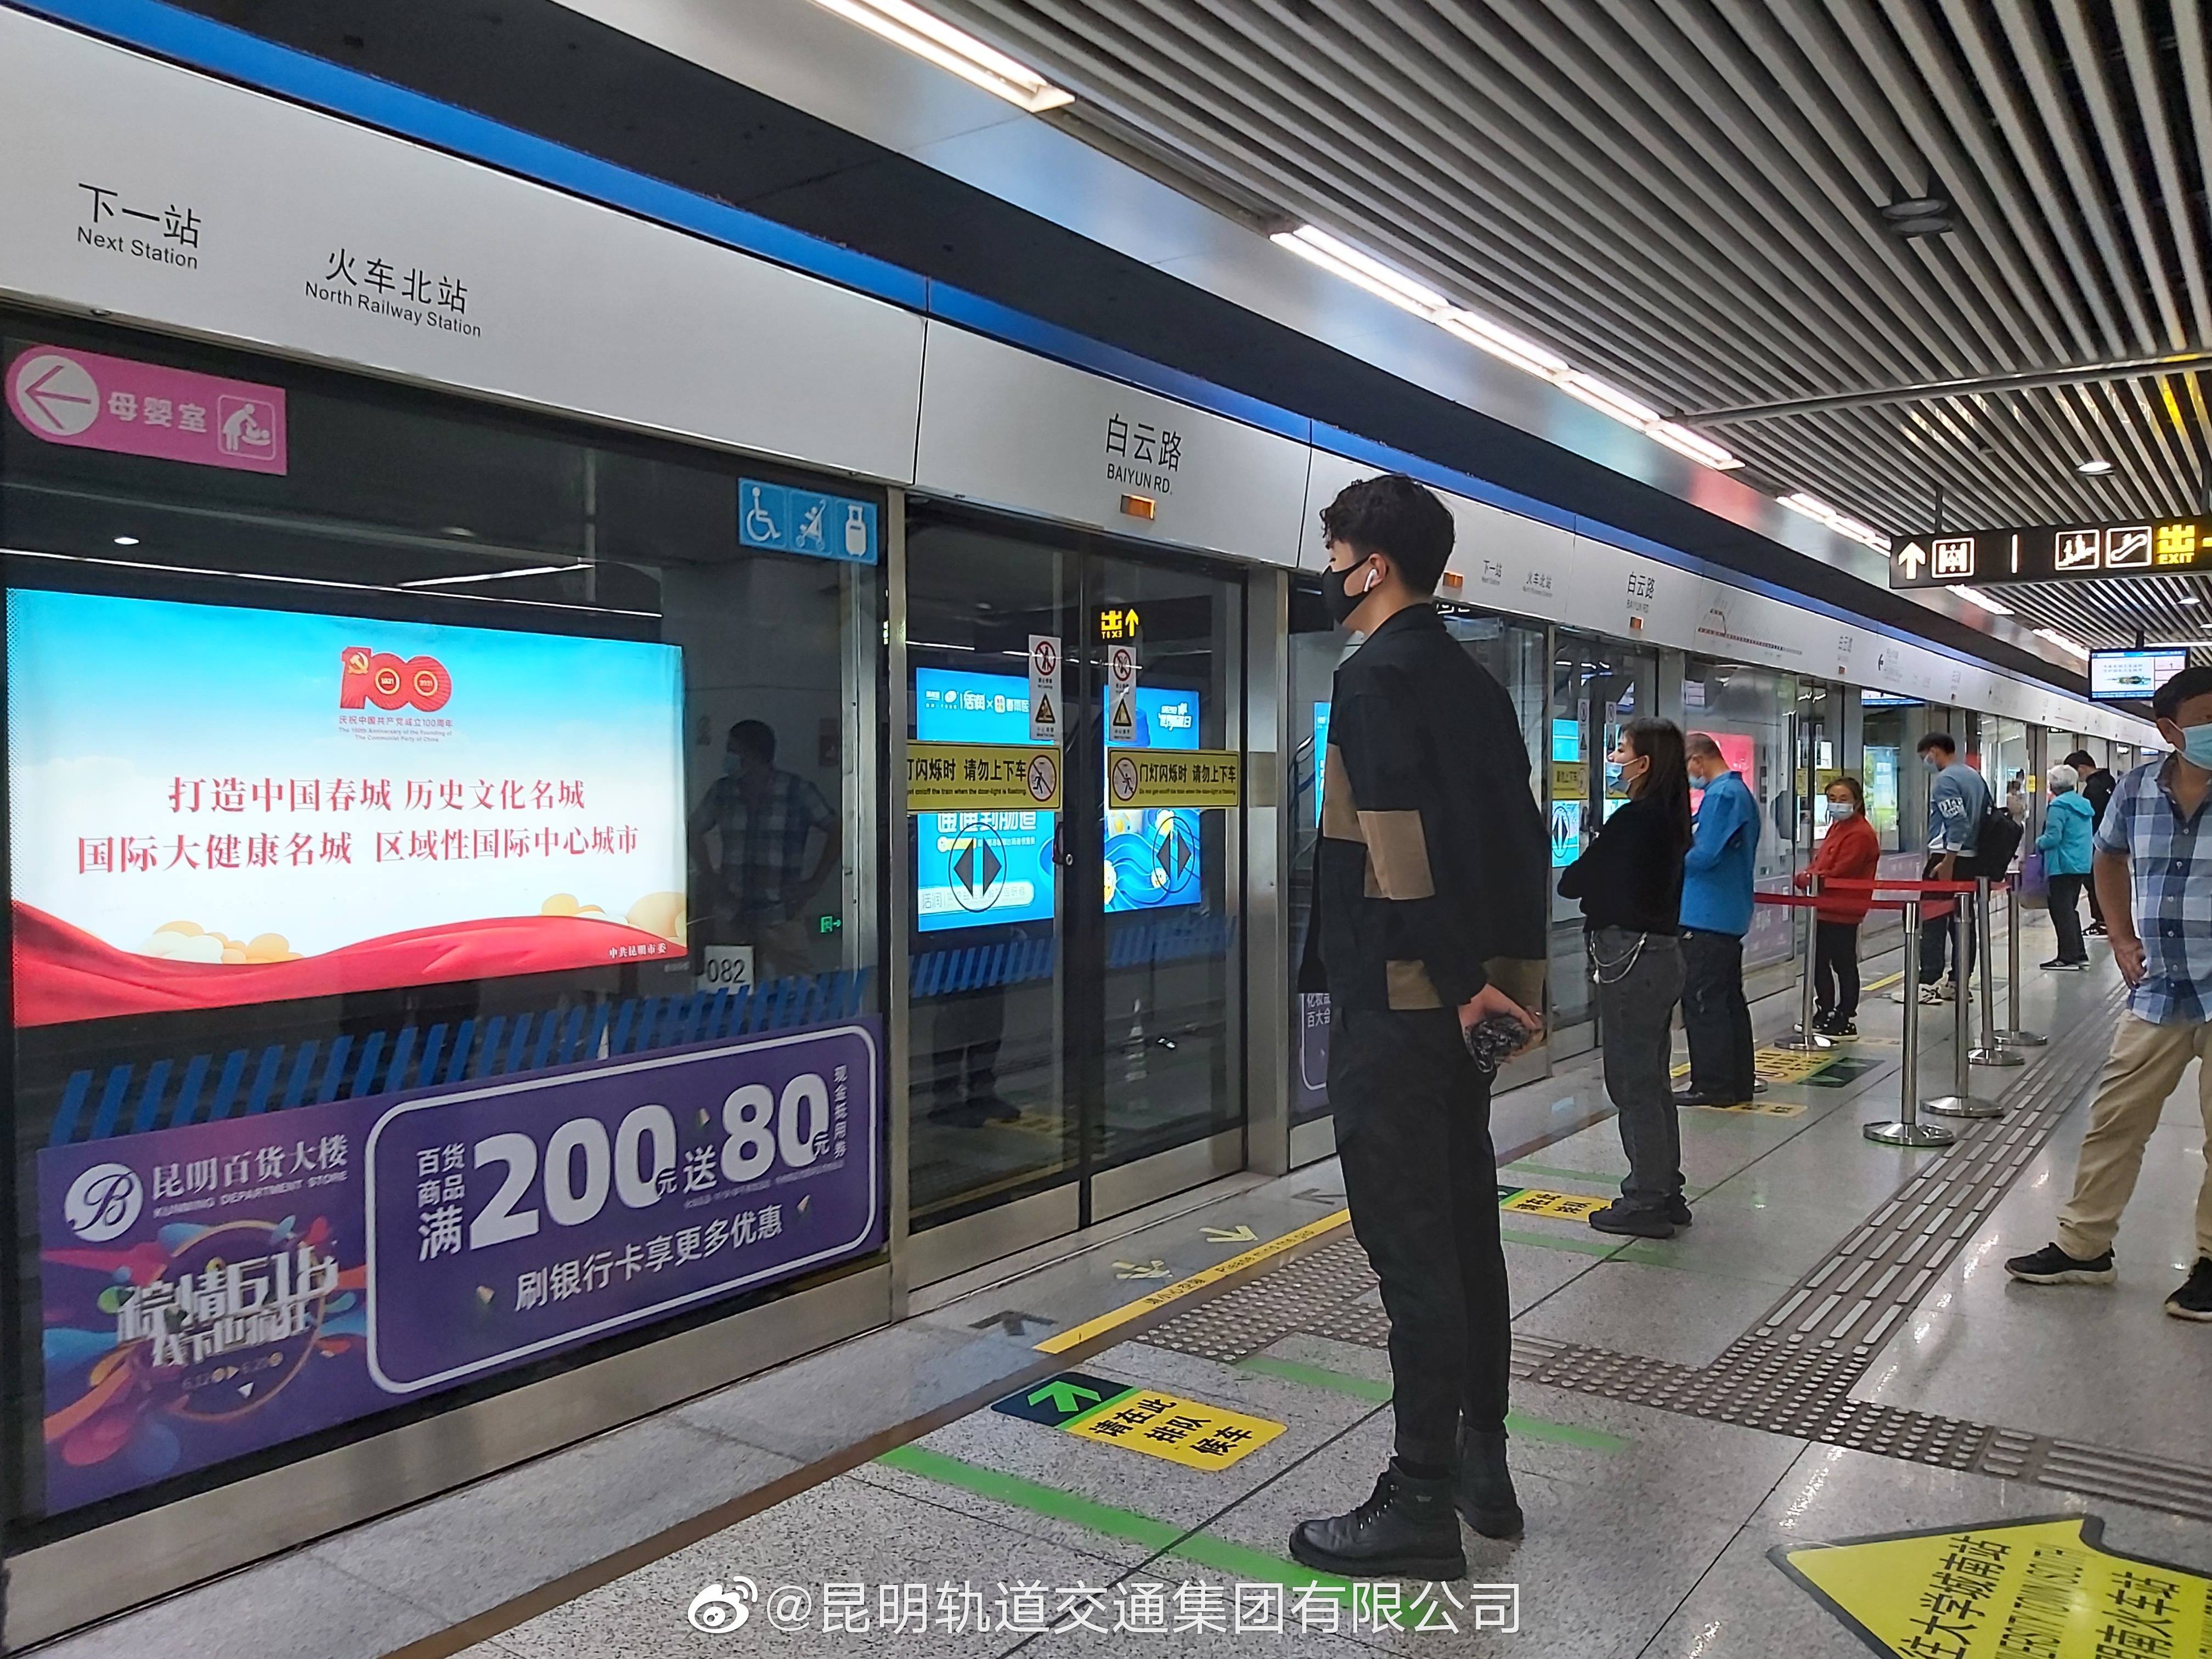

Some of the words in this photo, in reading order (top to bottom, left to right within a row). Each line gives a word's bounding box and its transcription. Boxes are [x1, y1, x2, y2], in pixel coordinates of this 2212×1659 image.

[78, 183, 202, 249] 下一站
[77, 225, 125, 253] Next
[131, 240, 199, 270] Station
[325, 247, 468, 314] 火车北站
[304, 280, 353, 307] North
[357, 294, 422, 326] Railway
[426, 311, 482, 338] Station
[108, 392, 207, 433] 母婴室
[1105, 413, 1182, 472] 白云路
[1107, 462, 1152, 489] BAIYUN
[1483, 560, 1502, 577] 下一站
[2158, 552, 2195, 565] EXIT
[1627, 571, 1655, 600] 白云路
[339, 715, 453, 727] 庆祝中国共产党成立100周年
[964, 759, 1026, 782] 请勿上下车
[1139, 763, 1187, 783] 门灯闪烁时
[1193, 764, 1236, 783] 请勿上下车
[168, 776, 392, 814] 打造中国春城
[404, 778, 585, 811] 历史文化名城
[78, 832, 352, 874] 国际大健康名城
[376, 825, 639, 863] 区域性国际中心城市
[608, 942, 667, 959] 中共昆明市委
[706, 958, 746, 984] 082
[152, 1133, 348, 1200] 昆明百货大楼
[416, 1142, 465, 1177] 百货
[469, 1103, 678, 1251] 200
[720, 1072, 830, 1183] 80
[221, 1179, 303, 1205] DEPARTMENT
[307, 1170, 348, 1189] STORE
[416, 1173, 465, 1207] 商品
[515, 1204, 783, 1312] 刷银行卡享更多优惠
[1088, 1397, 1177, 1437] 请在此
[1143, 1414, 1212, 1444] 排队
[1188, 1425, 1255, 1456] 候车
[1897, 1535, 2012, 1659] 往大学城南站
